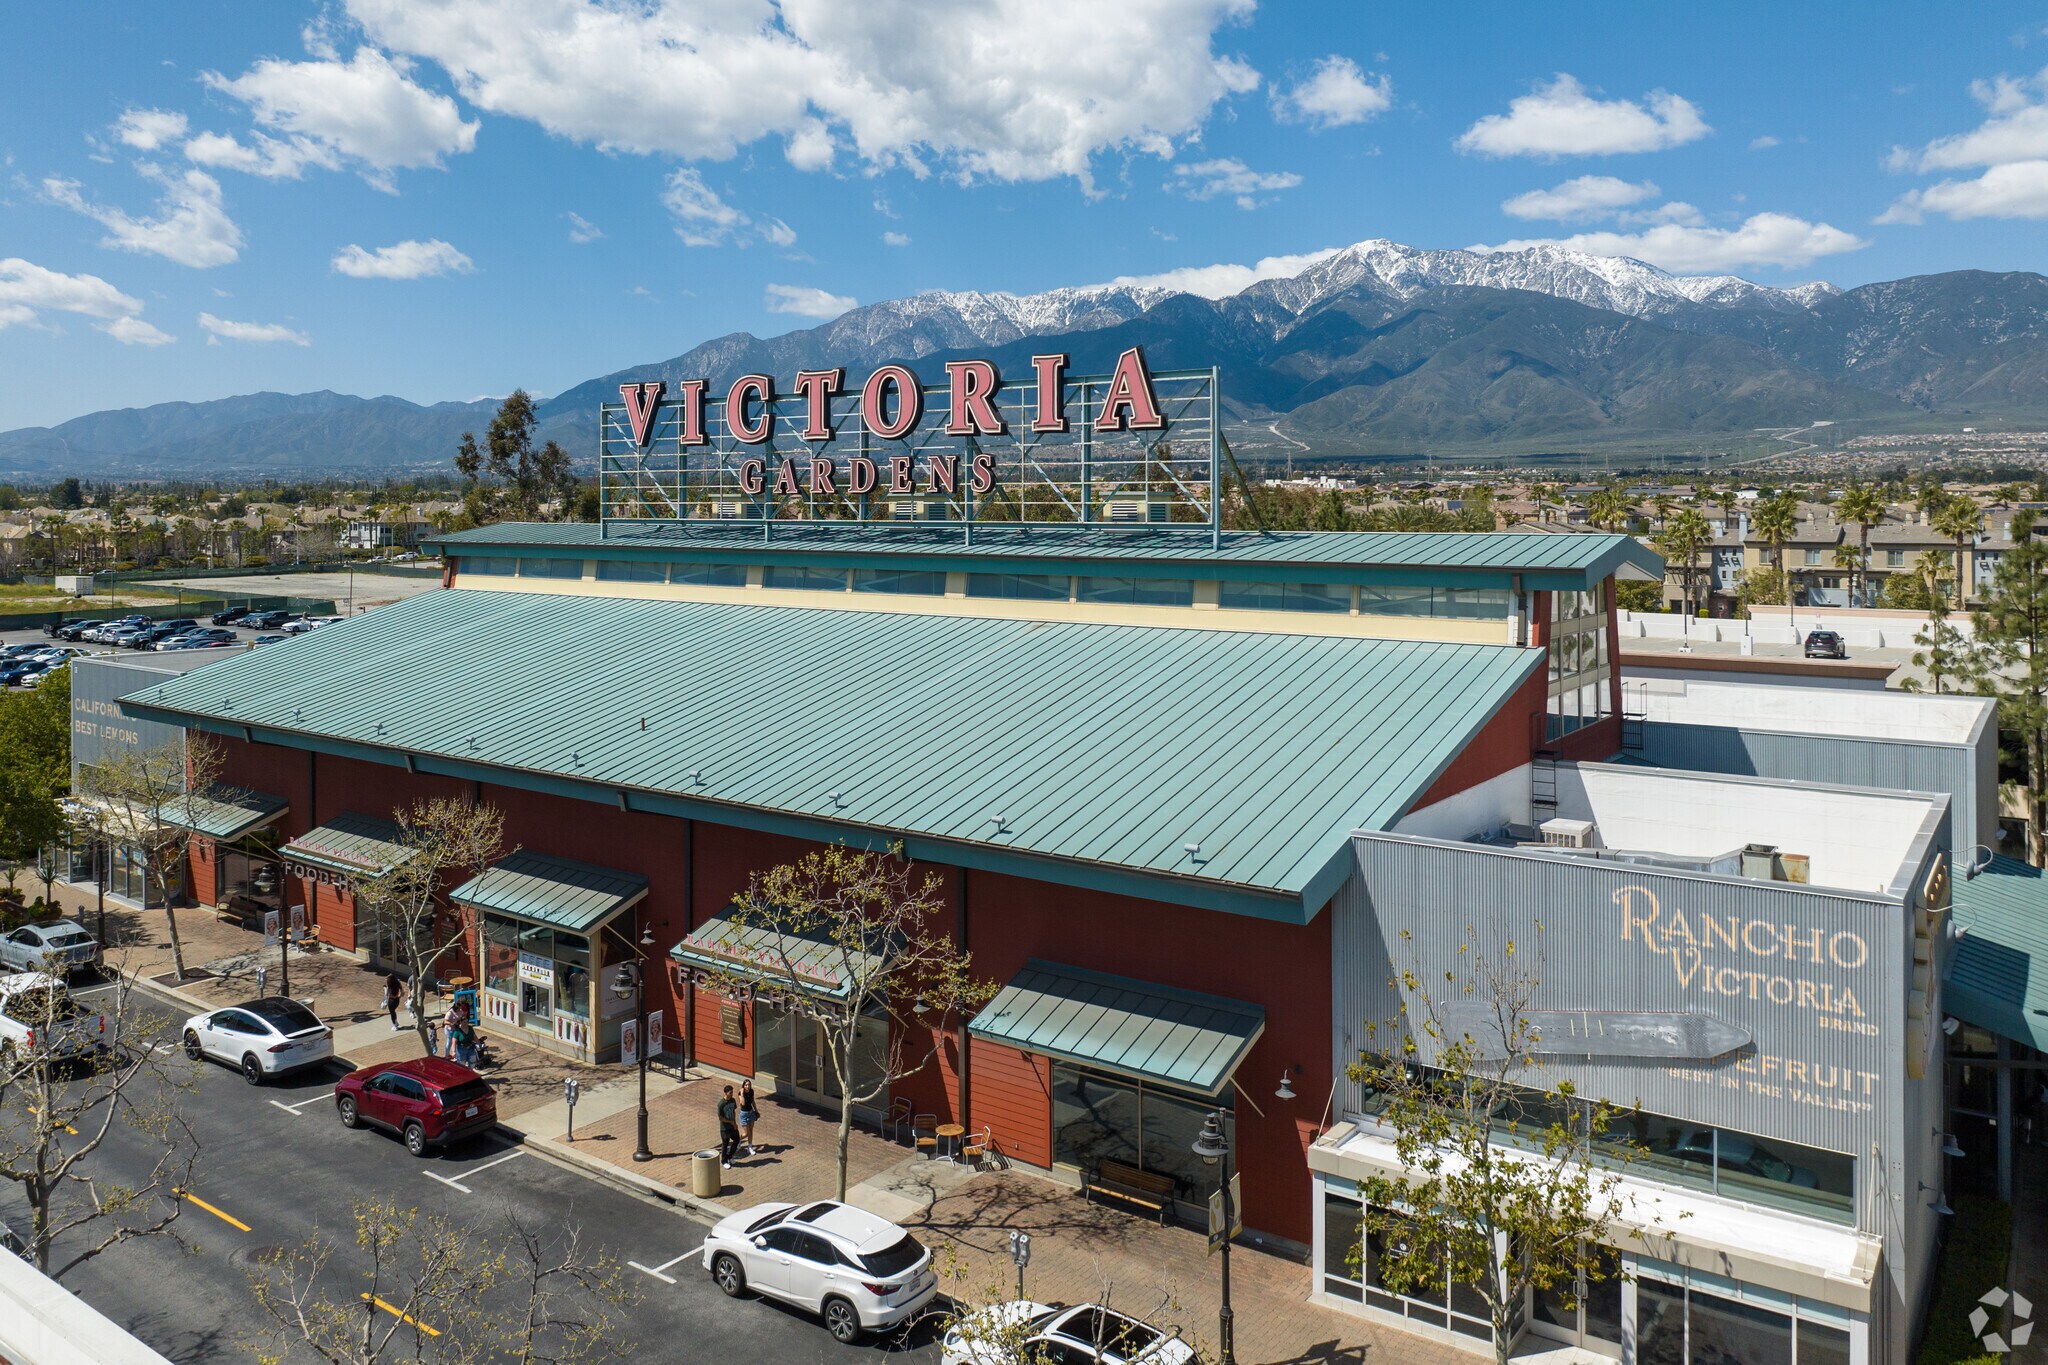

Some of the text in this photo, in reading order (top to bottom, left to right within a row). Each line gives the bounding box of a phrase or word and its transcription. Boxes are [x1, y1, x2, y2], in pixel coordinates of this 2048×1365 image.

[619, 345, 1169, 446] VICTORIA
[739, 453, 998, 496] GARDENS
[75, 698, 137, 721] CALIFORN
[75, 720, 138, 745] BEST LEMONS
[283, 861, 329, 885] FOOD
[1612, 885, 1868, 969] RANCHO
[757, 951, 838, 982] VICTORIA
[1670, 946, 1866, 1018] VICTORIA
[1818, 1016, 1879, 1037] BRAND
[1720, 1075, 1740, 1090] IN
[1746, 1080, 1782, 1099] THE
